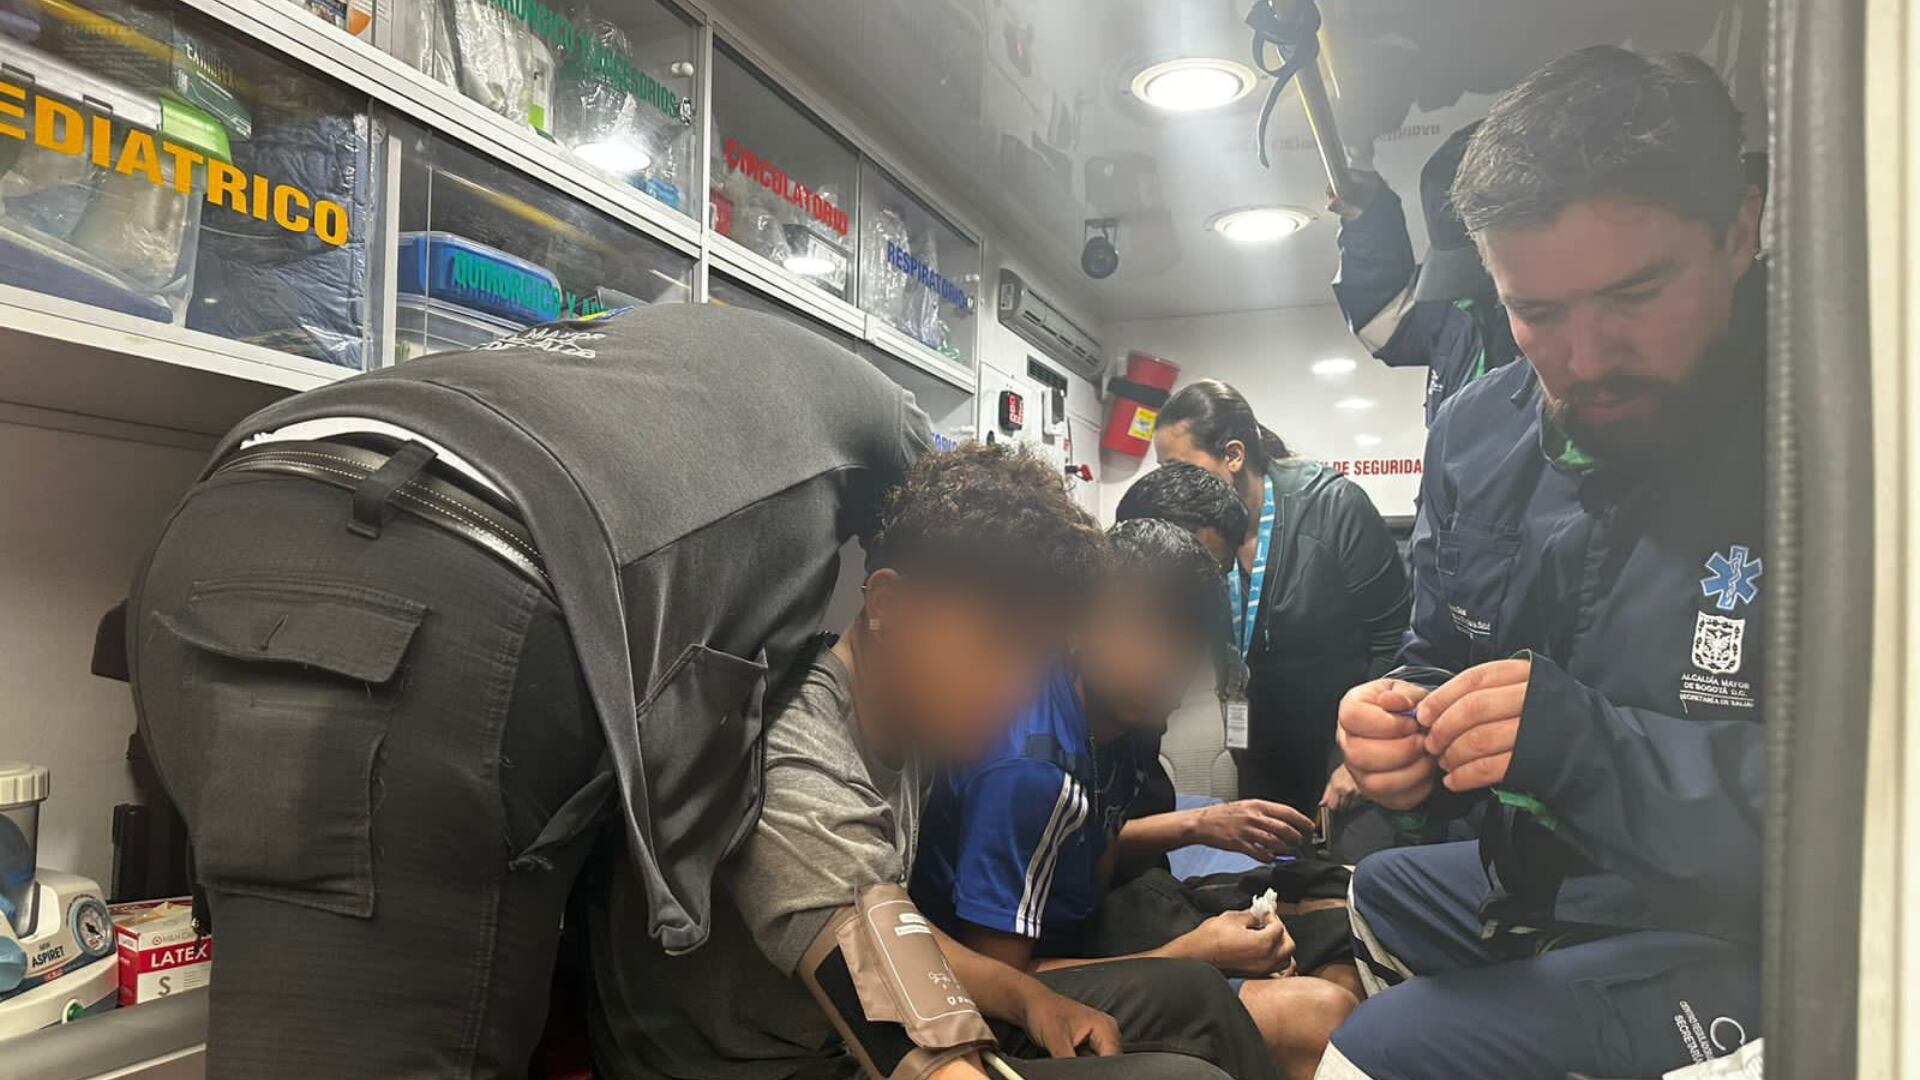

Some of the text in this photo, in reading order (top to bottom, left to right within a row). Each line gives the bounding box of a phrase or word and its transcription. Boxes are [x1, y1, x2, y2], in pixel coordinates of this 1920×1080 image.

[725, 138, 848, 236] CIRCULATORIO
[887, 240, 968, 309] RESPIRATORIO
[1354, 459, 1422, 475] SEGURIDA
[1681, 673, 1750, 689] ALCALDÍA MAYOR
[151, 945, 207, 969] LATEX
[158, 976, 171, 997] S
